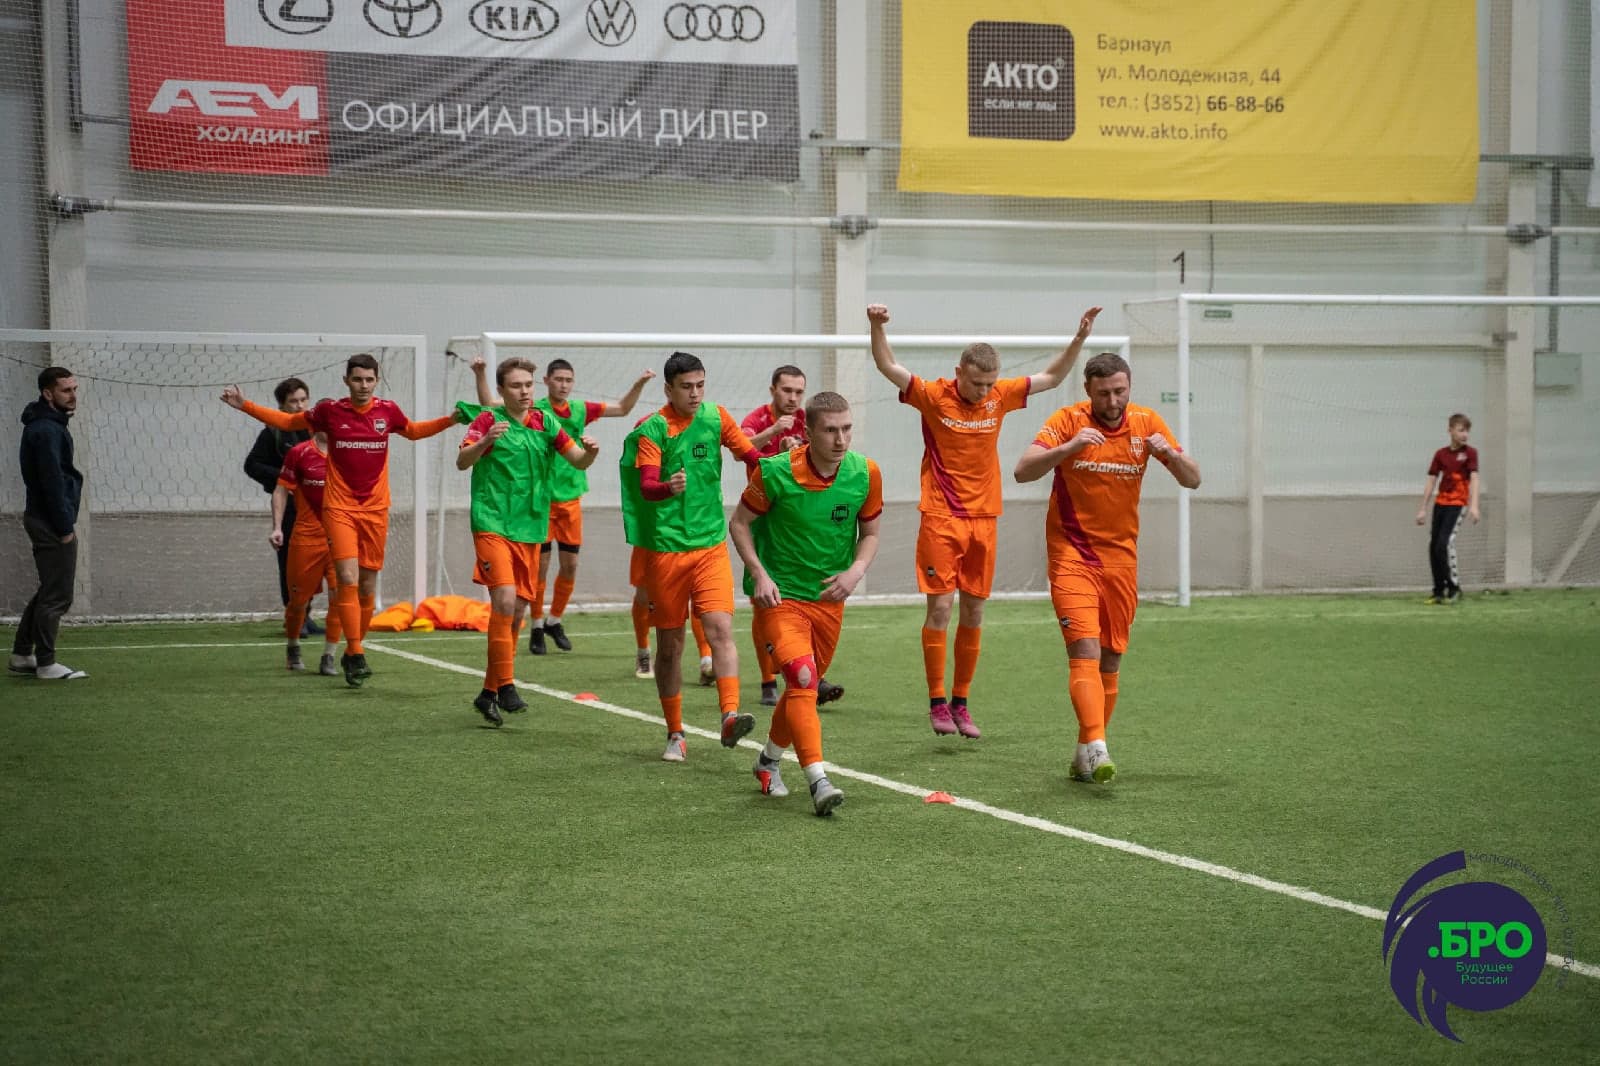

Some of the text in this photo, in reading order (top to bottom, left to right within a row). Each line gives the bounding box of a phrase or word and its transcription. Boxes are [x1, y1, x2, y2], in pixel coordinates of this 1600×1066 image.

[485, 8, 546, 31] KIA
[1097, 33, 1172, 56] Барнаул
[1097, 64, 1281, 87] ул. Молодежная, 44
[1098, 92, 1285, 115] тел.: (3852) 66-88-66
[342, 98, 768, 146] ОФИЦИАЛЬНЫЙ ДИЛЕР
[1100, 122, 1228, 140] www.akto.info
[1172, 250, 1185, 284] 1
[1072, 459, 1145, 475] ПРОДИНВЕС
